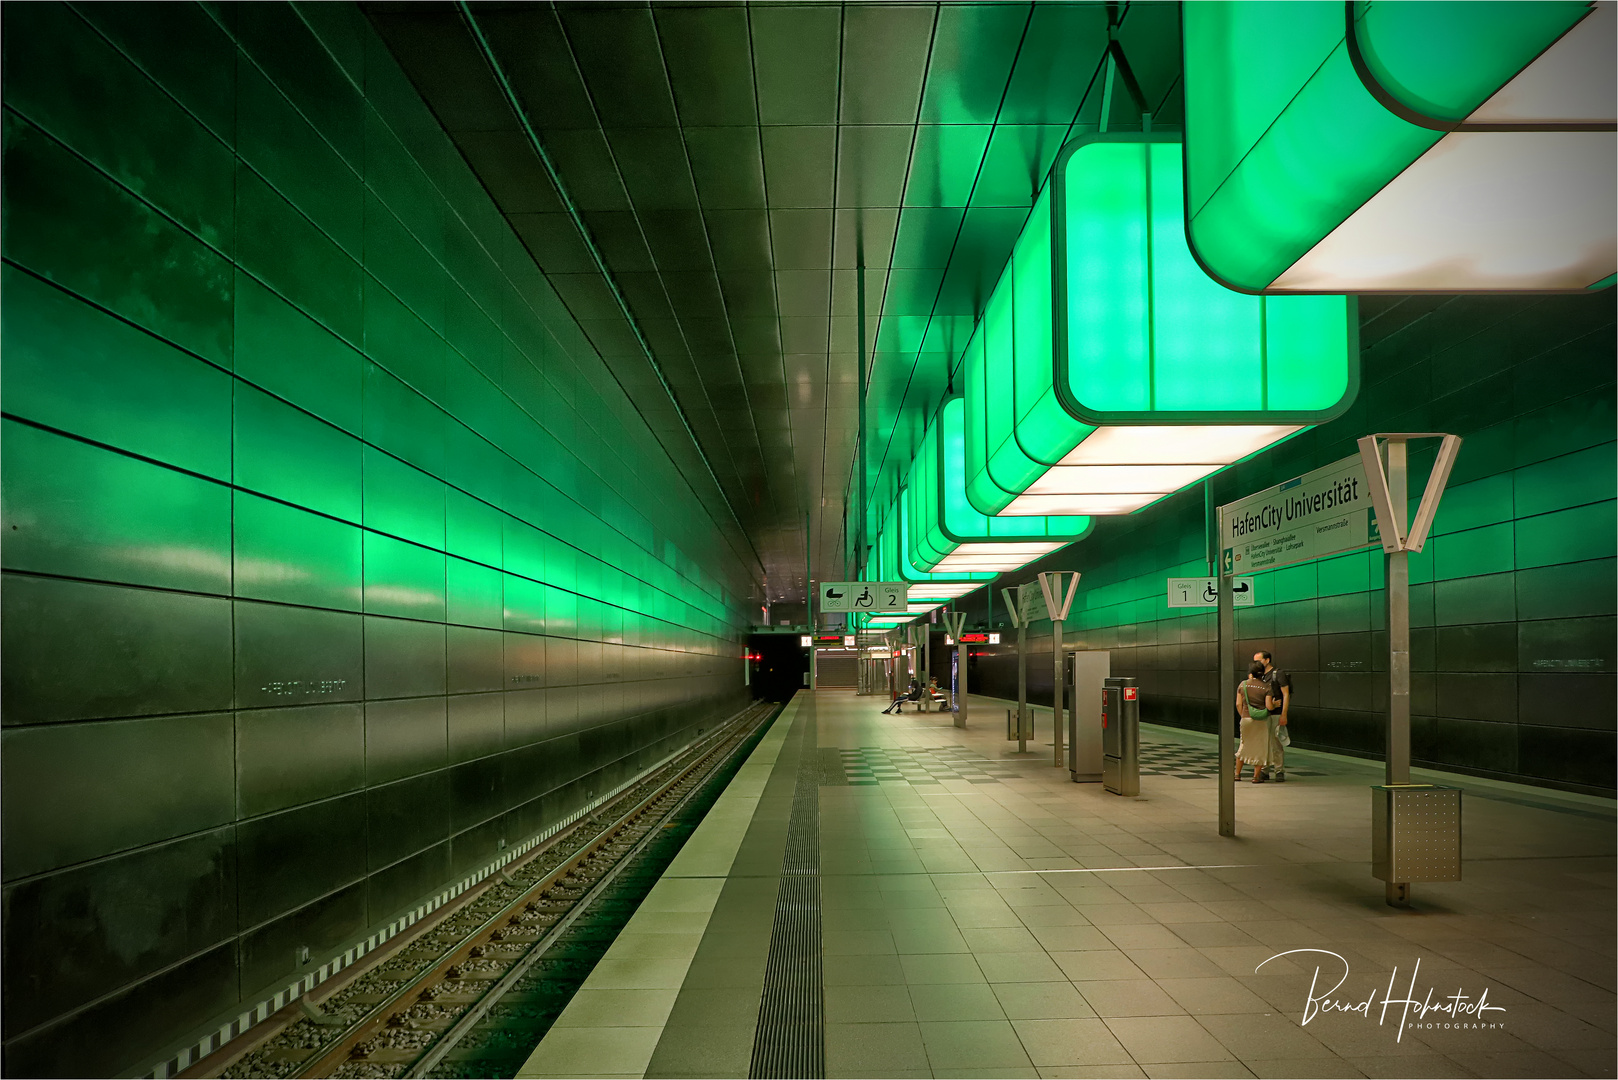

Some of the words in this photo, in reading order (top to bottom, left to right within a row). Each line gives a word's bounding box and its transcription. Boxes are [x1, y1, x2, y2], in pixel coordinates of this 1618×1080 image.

[1232, 504, 1283, 538] HafenCity
[1285, 477, 1359, 522] Universität
[888, 594, 897, 606] 2
[1182, 590, 1187, 602] 1
